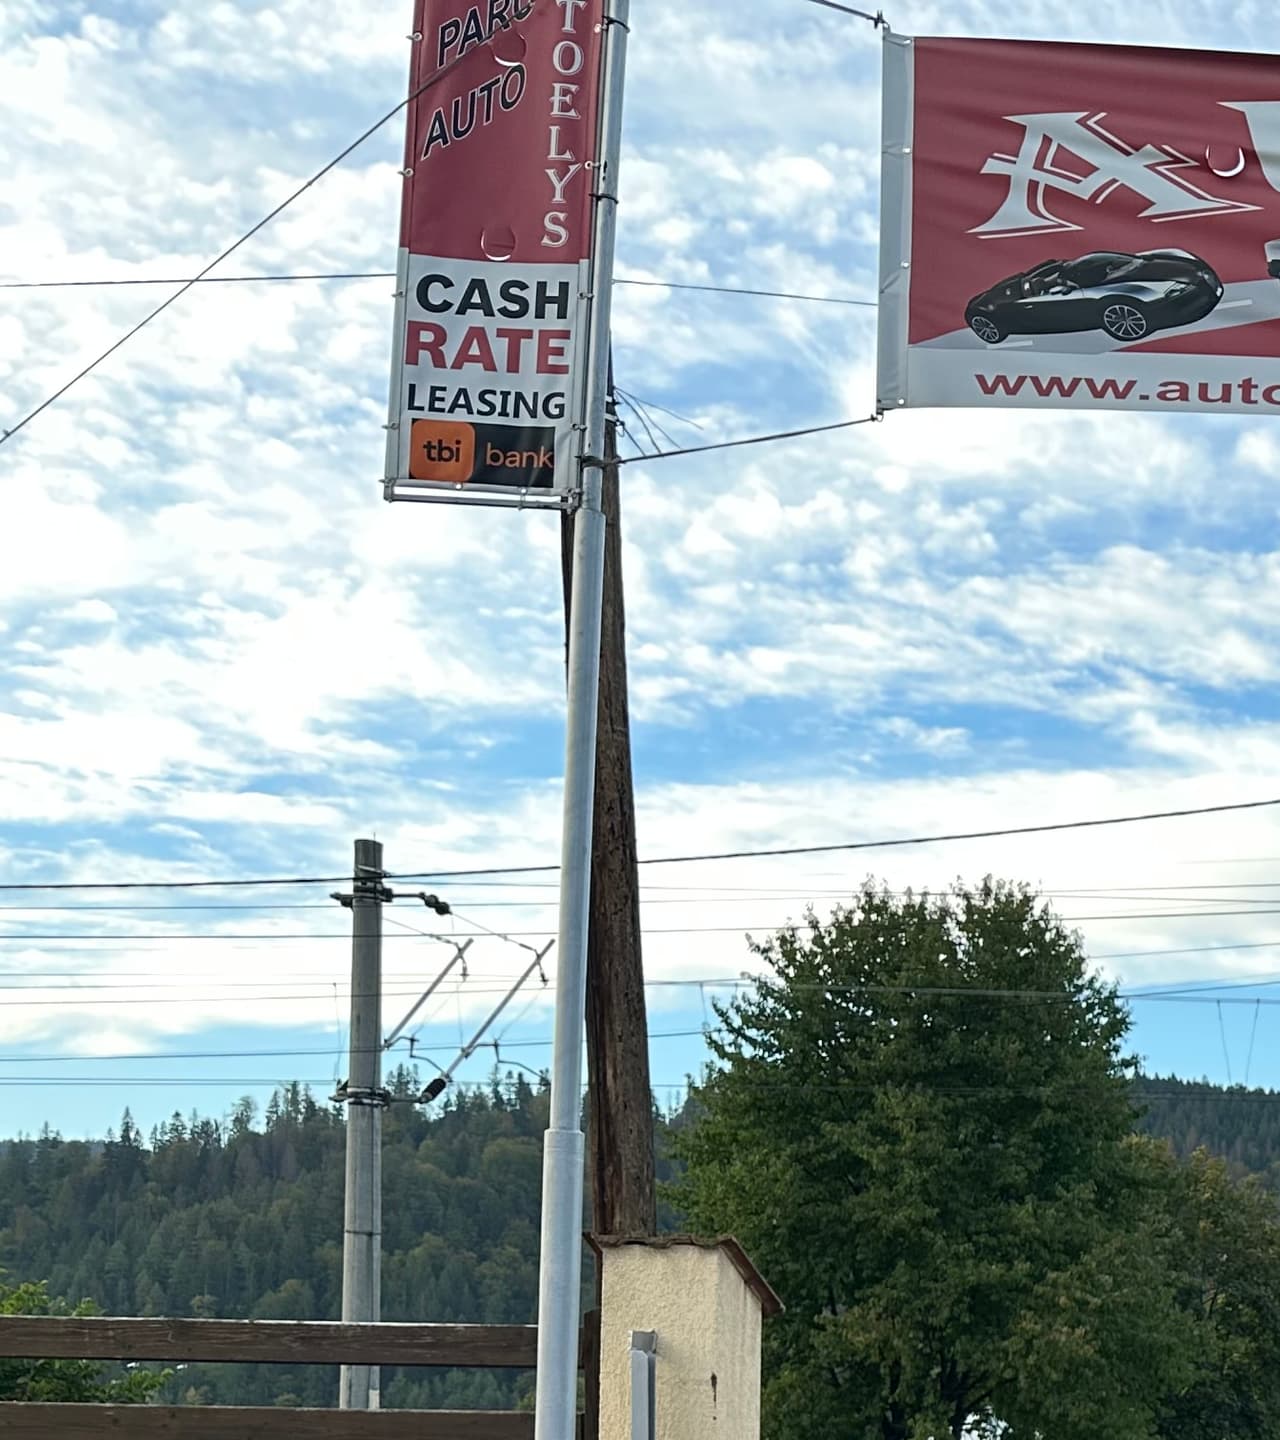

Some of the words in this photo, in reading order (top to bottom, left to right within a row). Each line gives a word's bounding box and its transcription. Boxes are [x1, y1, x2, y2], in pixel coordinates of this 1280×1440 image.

[437, 0, 534, 69] PARC
[421, 63, 527, 161] AUTO
[416, 274, 570, 320] CASH
[405, 320, 571, 375] RATE
[407, 383, 566, 420] LEASING
[422, 439, 462, 463] tbi
[485, 442, 554, 469] bank
